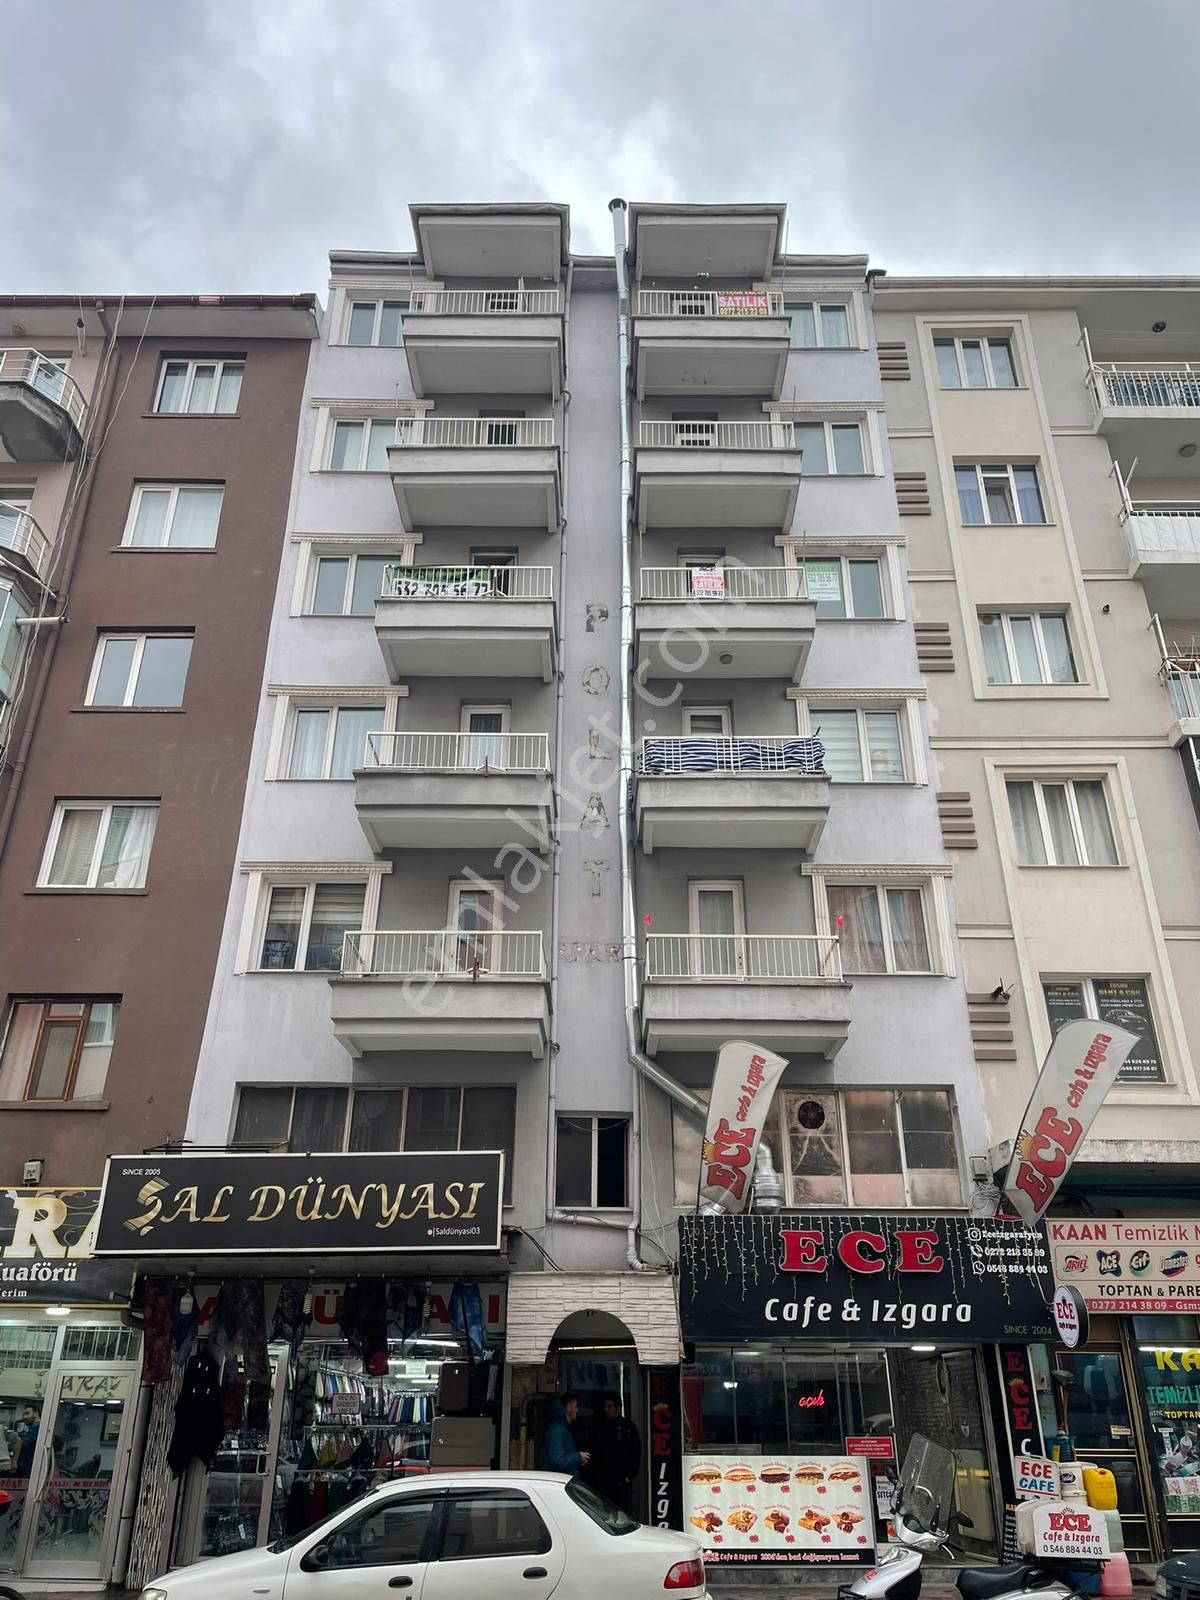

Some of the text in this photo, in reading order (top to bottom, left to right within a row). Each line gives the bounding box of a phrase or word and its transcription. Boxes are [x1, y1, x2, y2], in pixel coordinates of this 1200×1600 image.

[719, 296, 767, 307] SATILIK
[1067, 1079, 1089, 1108] cafe
[707, 1118, 756, 1200] ECE
[1015, 1107, 1083, 1213] ECE
[122, 1176, 485, 1236] ŞAL DÜNYASI
[1052, 1224, 1107, 1240] KAAN
[1112, 1224, 1189, 1240] Temizlik
[778, 1230, 944, 1274] ECE
[985, 1247, 1005, 1256] 0272
[1037, 1265, 1048, 1274] 03
[1065, 1260, 1088, 1270] ARIEL
[1101, 1254, 1119, 1271] ACE
[1098, 1285, 1152, 1296] TOPTAN
[1157, 1287, 1165, 1296] &
[765, 1296, 972, 1329] Cafe & Izgara
[1056, 1302, 1076, 1320] ECE
[1003, 1325, 1052, 1334] SINCE 2004
[1006, 1351, 1033, 1431] ECE
[652, 1375, 672, 1457] ECE
[1164, 1411, 1200, 1419] TOPTAN
[1020, 1461, 1052, 1479] ECE
[1019, 1477, 1055, 1492] CAFE
[1048, 1513, 1092, 1532] ECE
[1043, 1532, 1100, 1544] Cafe & Izgara
[720, 1552, 733, 1562] Cafe
[1043, 1544, 1103, 1555] 0 546 884 44 03
